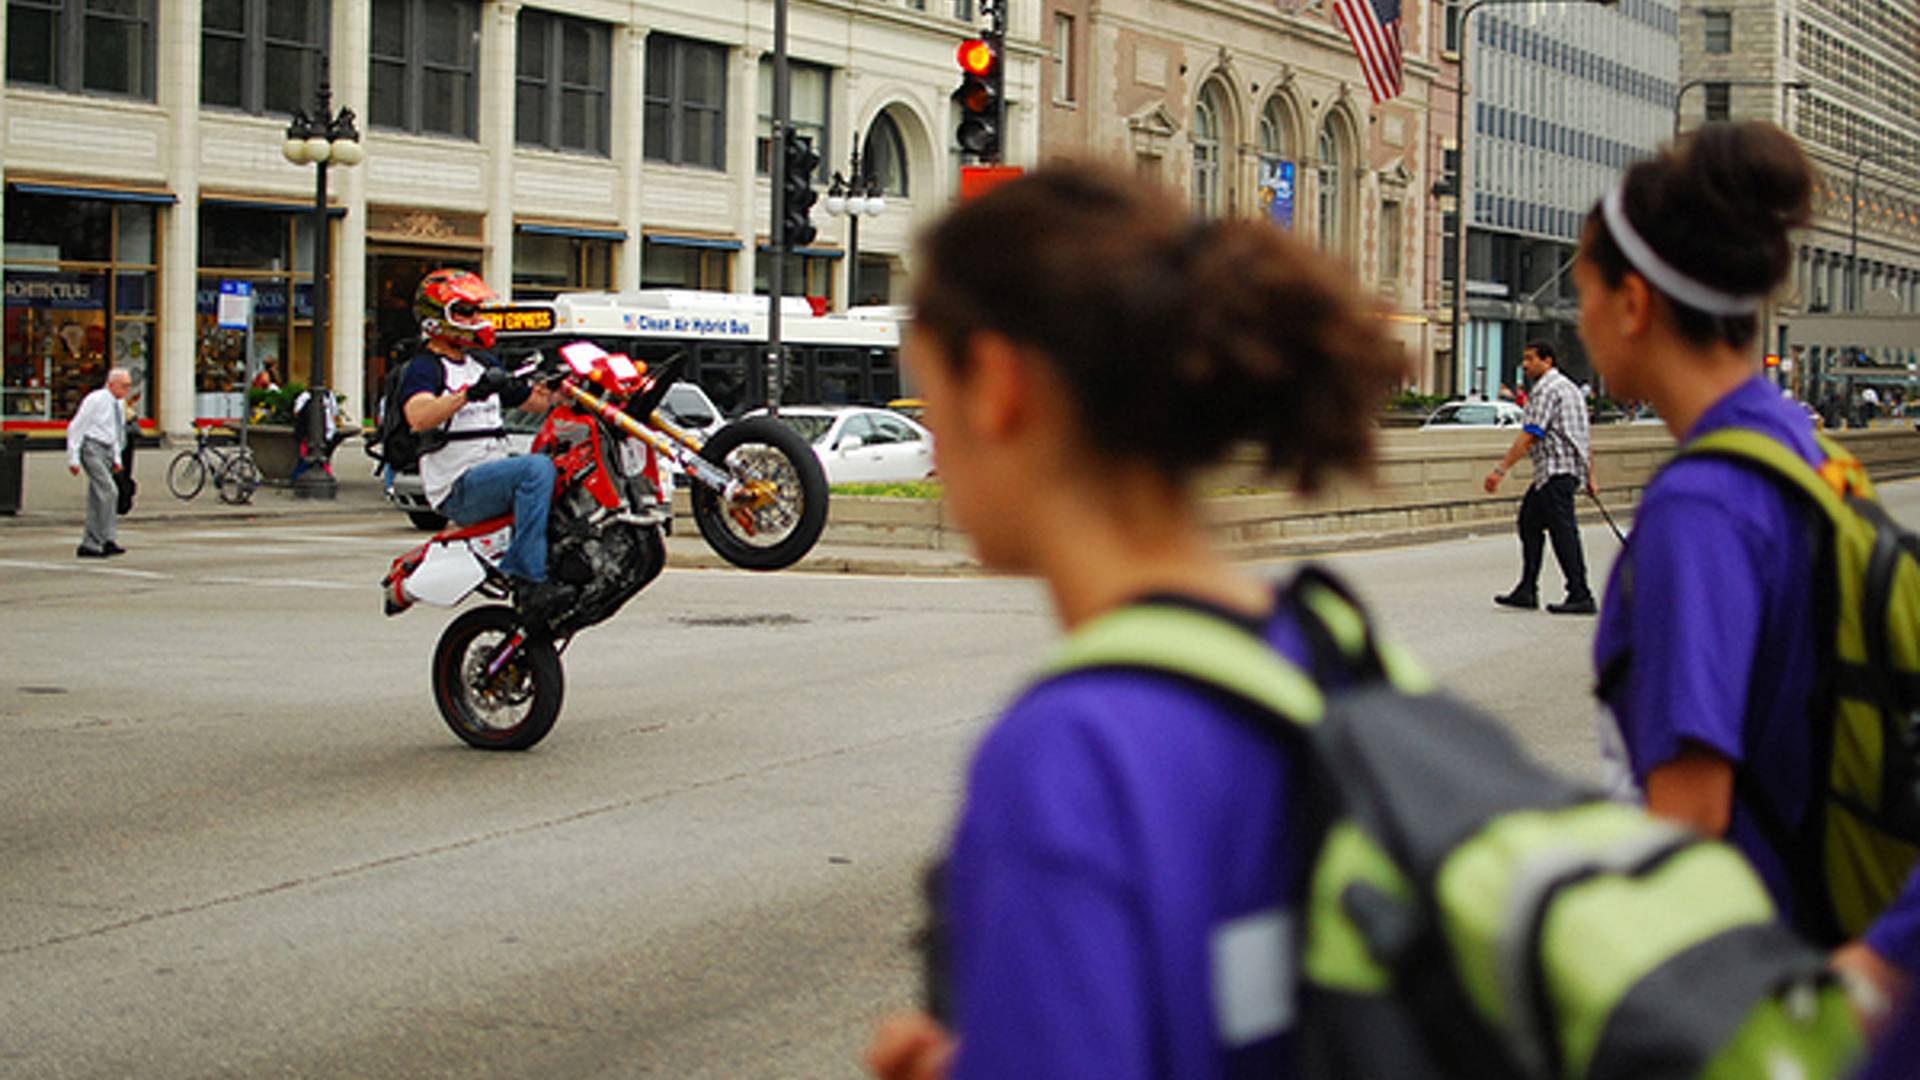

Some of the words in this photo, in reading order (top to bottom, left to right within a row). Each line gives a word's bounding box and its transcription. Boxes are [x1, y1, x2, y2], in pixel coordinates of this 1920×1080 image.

[505, 310, 551, 330] EXPRESS
[639, 314, 671, 332] Clean
[674, 317, 690, 332] Air
[691, 317, 727, 336] Hybrid
[730, 319, 750, 335] Bus
